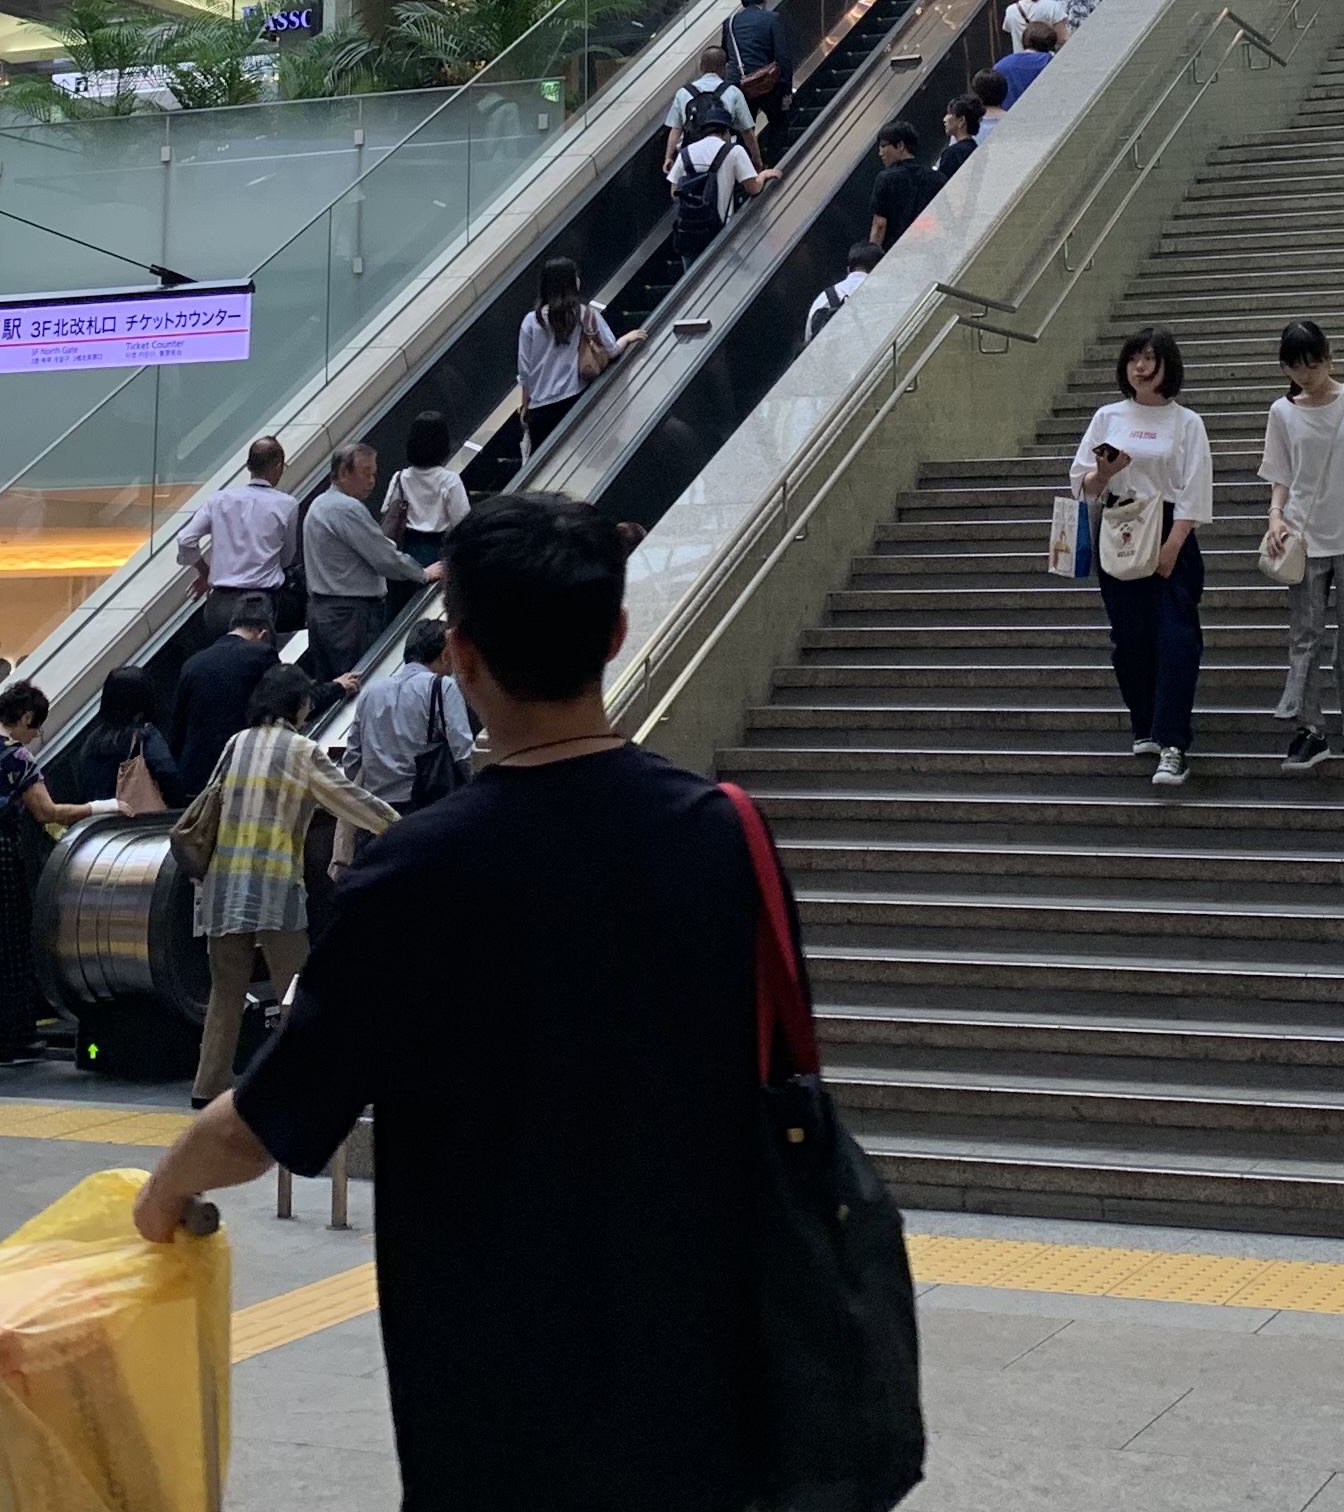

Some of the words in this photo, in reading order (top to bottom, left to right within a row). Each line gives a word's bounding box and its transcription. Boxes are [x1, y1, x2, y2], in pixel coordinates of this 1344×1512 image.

[31, 315, 116, 338] 3F北改札口
[125, 308, 242, 331] チケットカウンター
